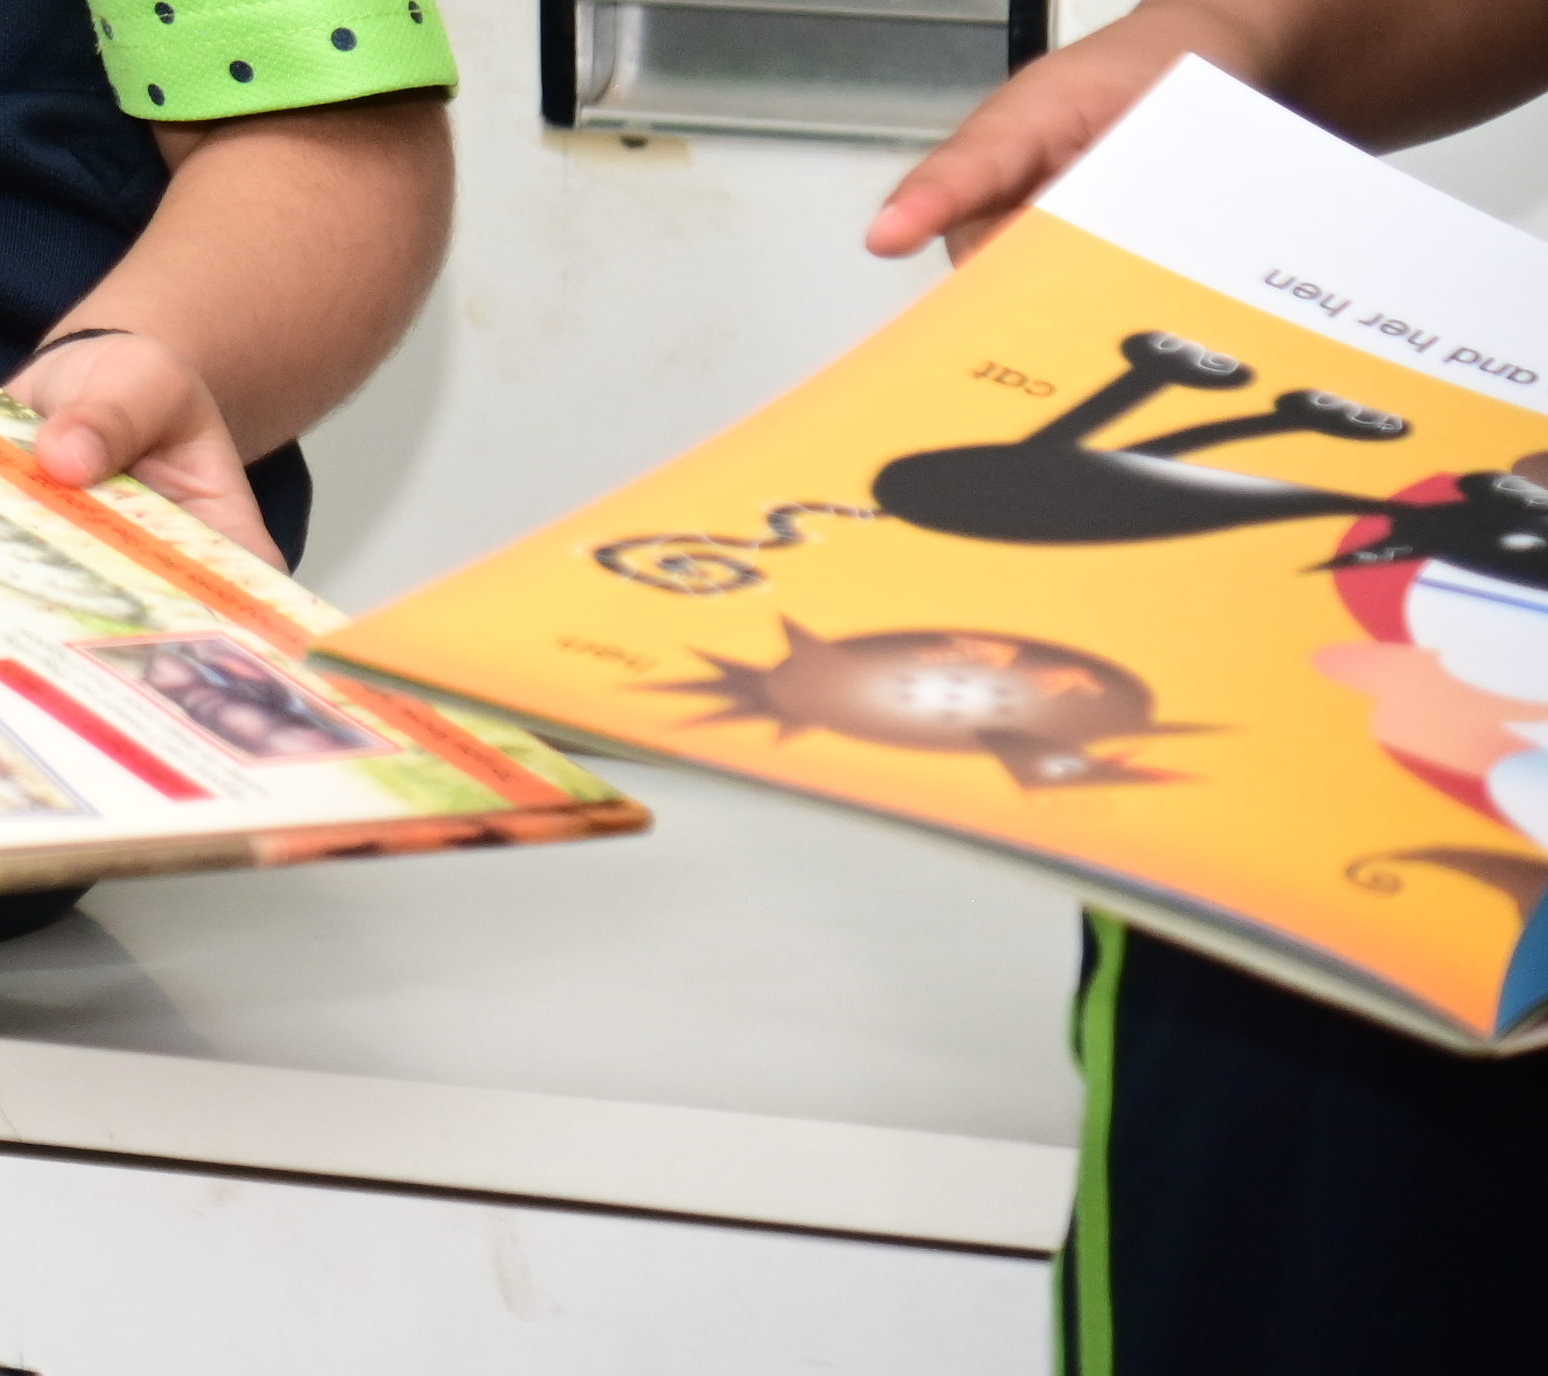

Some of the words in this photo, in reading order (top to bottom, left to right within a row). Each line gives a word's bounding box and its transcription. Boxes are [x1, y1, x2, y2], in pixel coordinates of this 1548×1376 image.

[1262, 267, 1353, 317] hen
[1356, 302, 1440, 353] her
[971, 359, 1059, 397] cat
[1443, 345, 1540, 385] and
